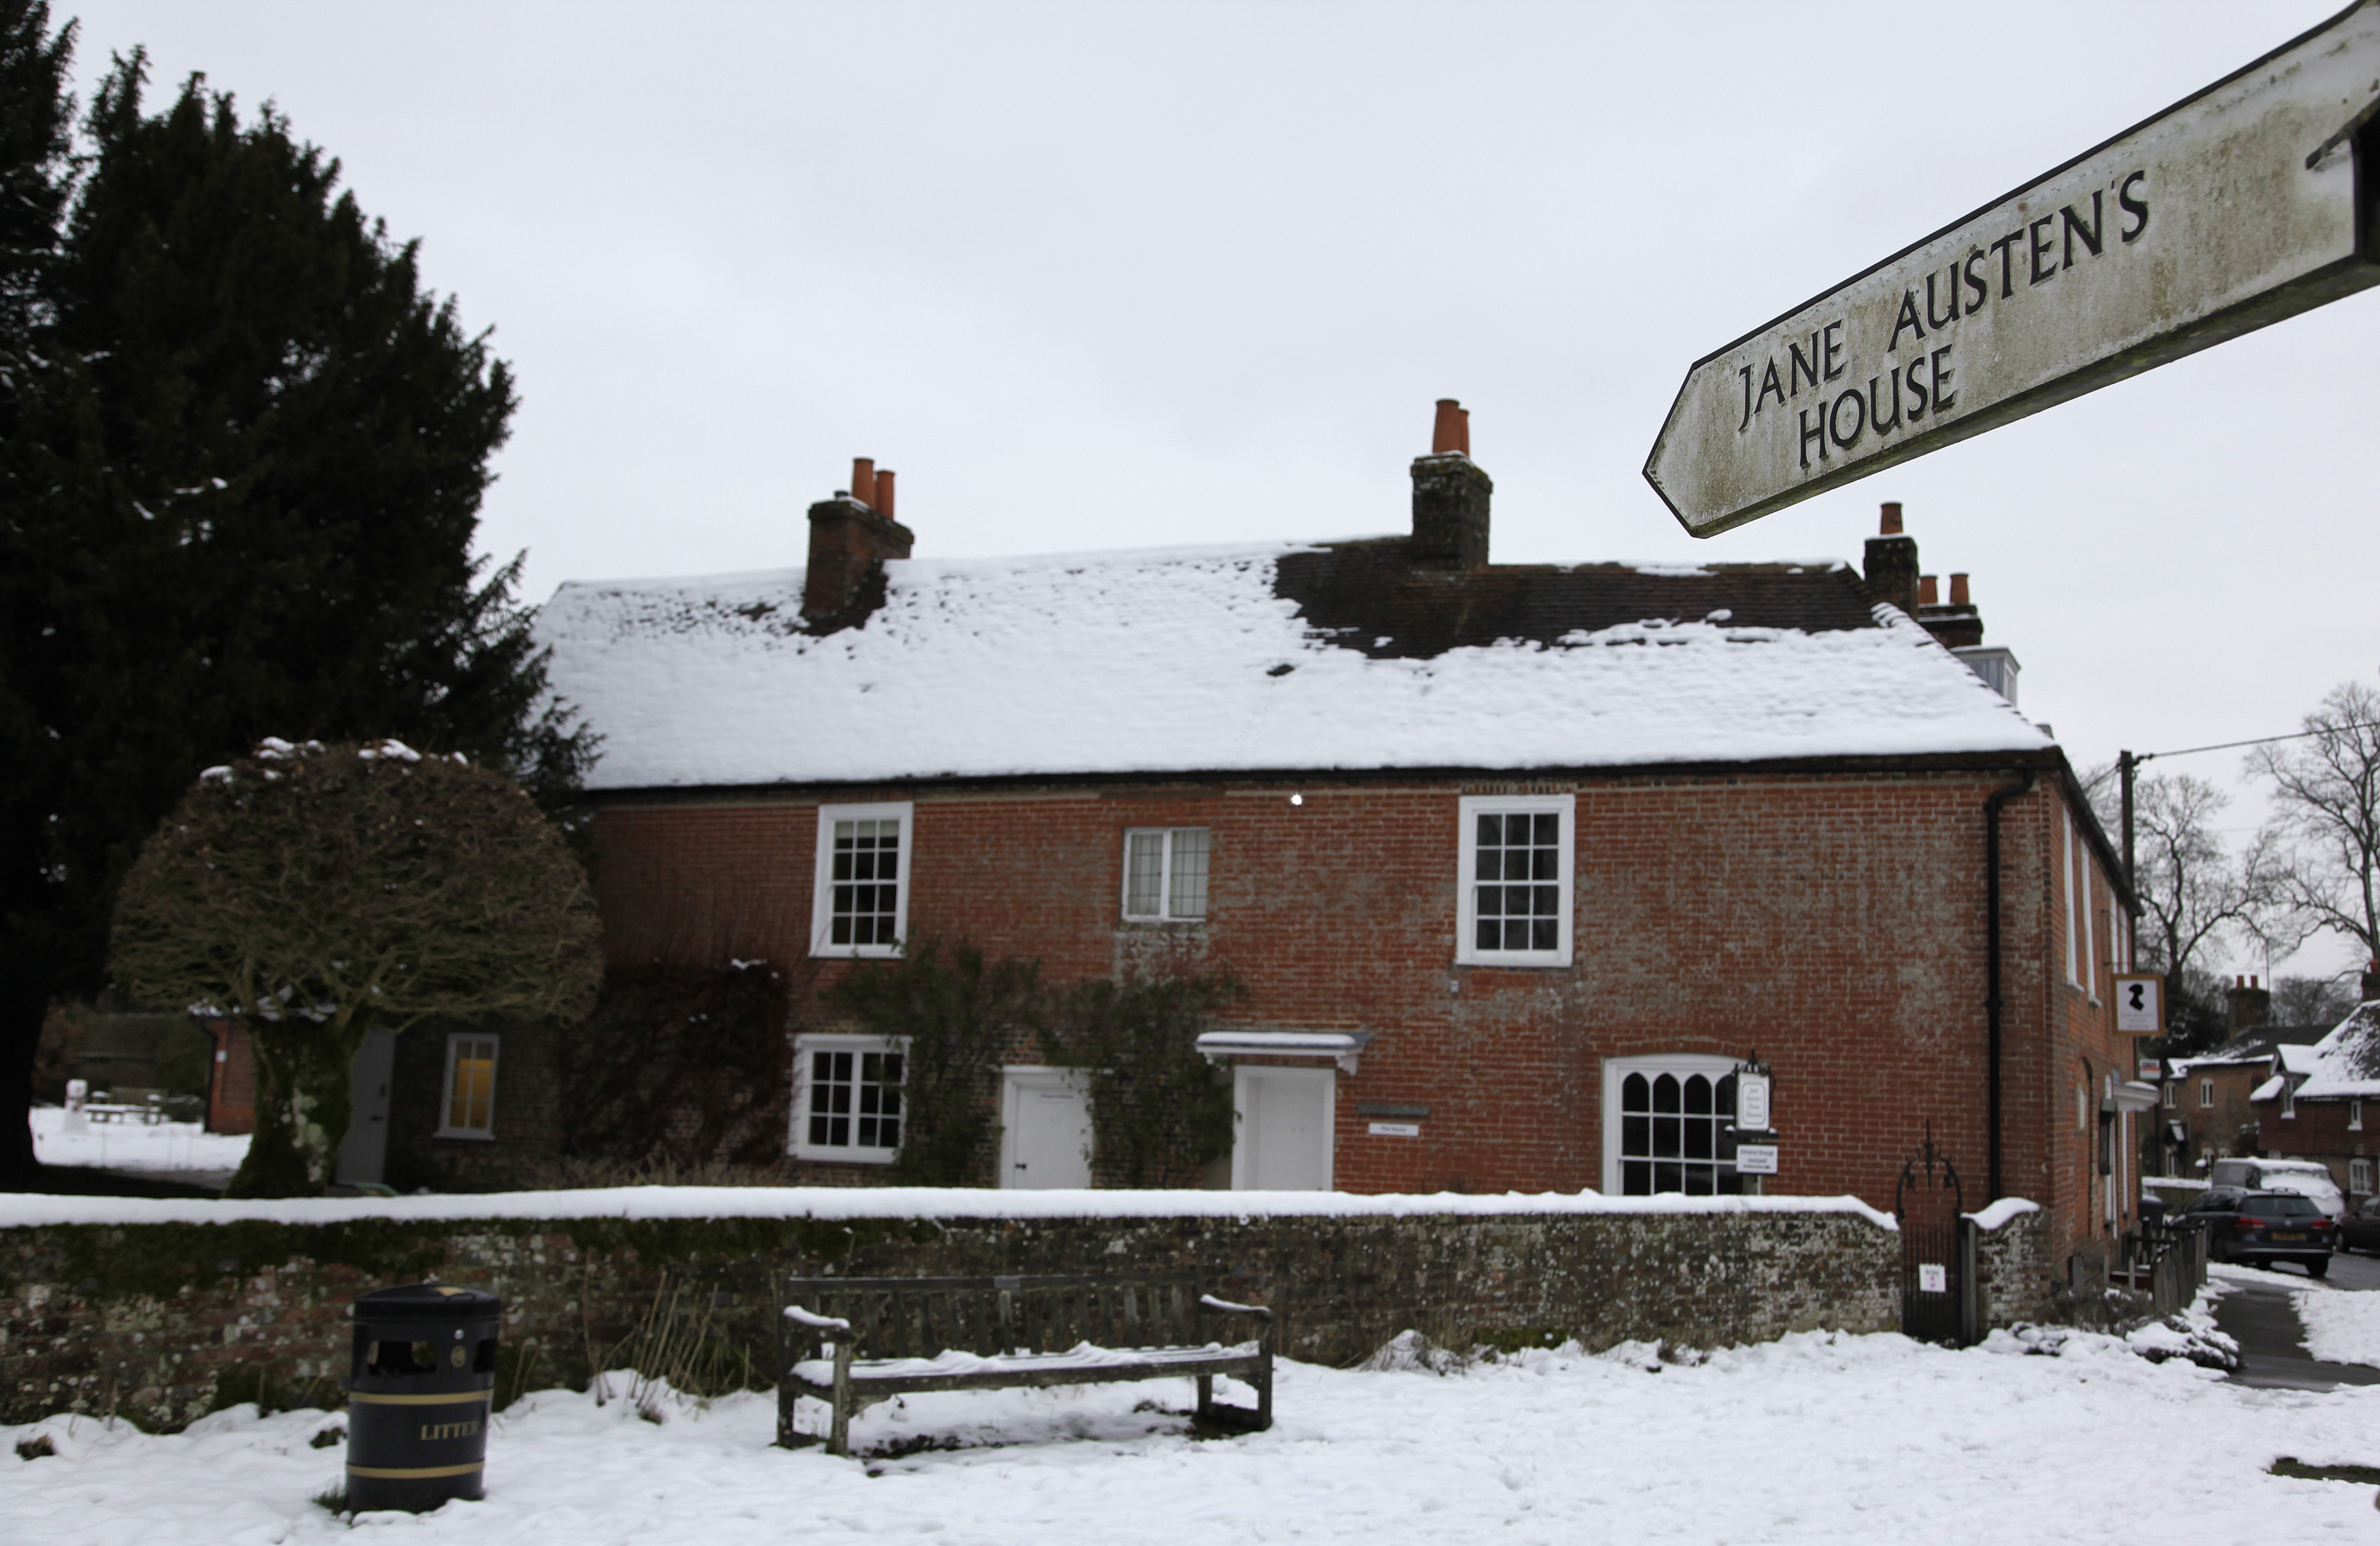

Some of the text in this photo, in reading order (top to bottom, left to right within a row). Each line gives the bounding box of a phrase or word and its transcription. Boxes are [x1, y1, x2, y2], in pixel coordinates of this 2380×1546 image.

[1738, 170, 2149, 432] JANE AUSTEN'S
[1799, 344, 1954, 468] HOUSE
